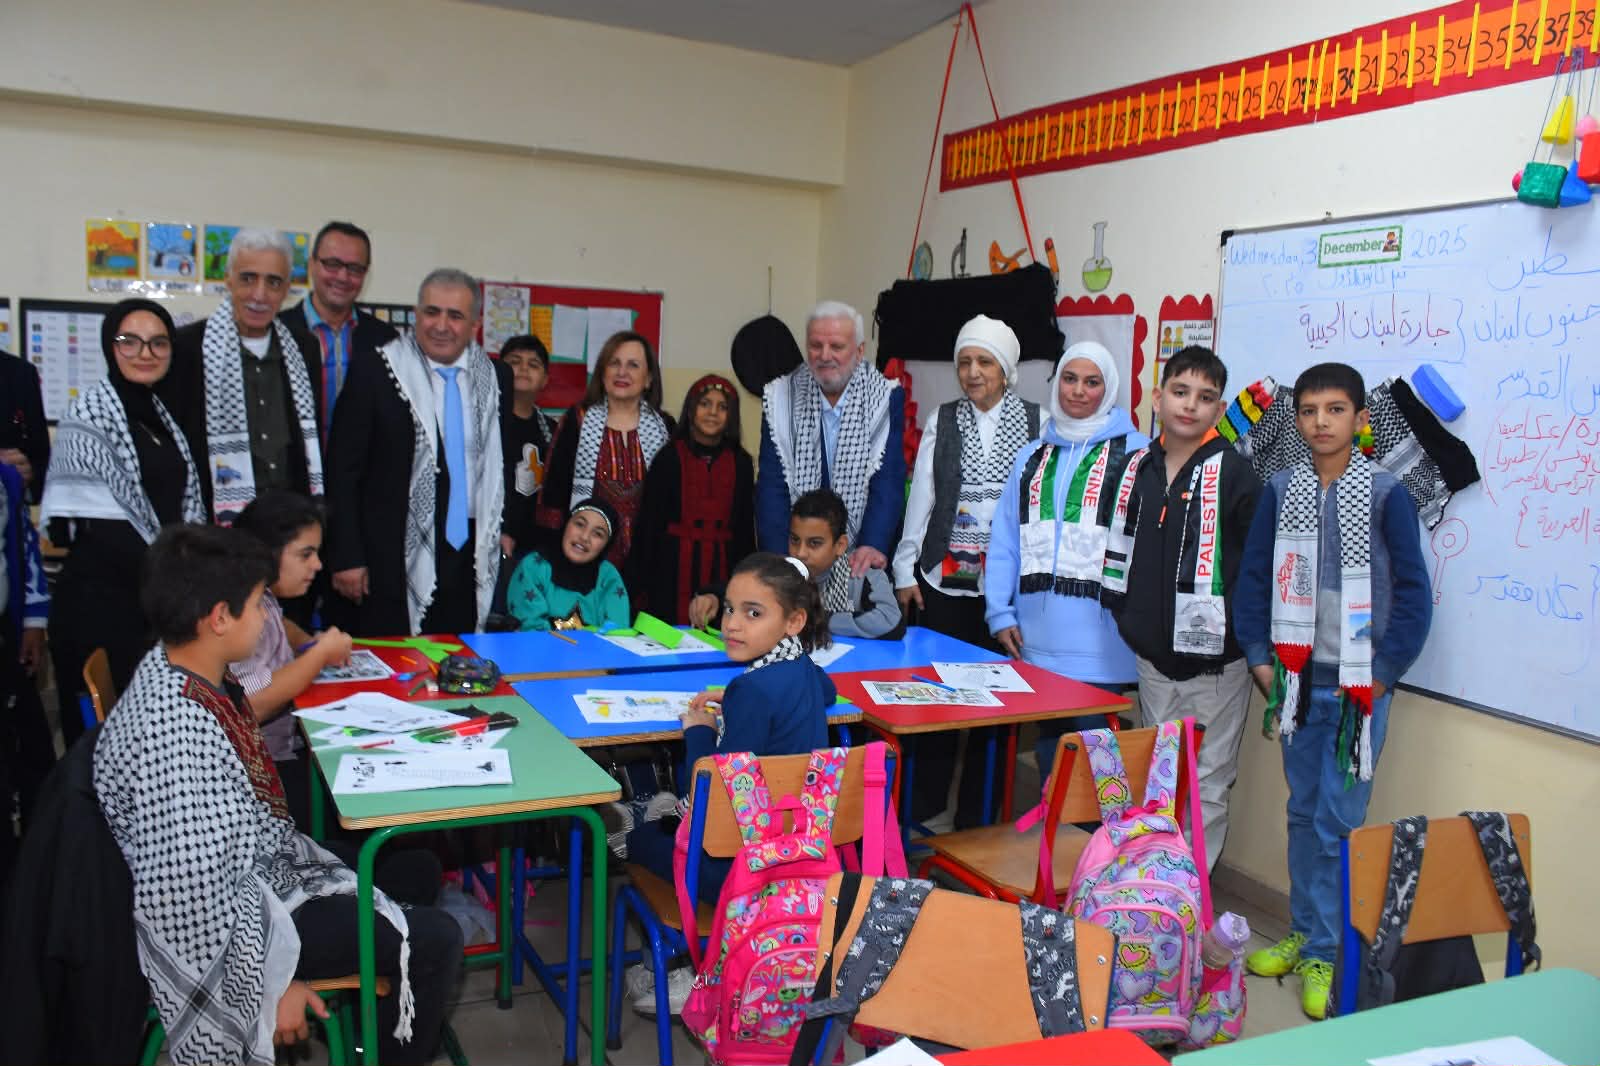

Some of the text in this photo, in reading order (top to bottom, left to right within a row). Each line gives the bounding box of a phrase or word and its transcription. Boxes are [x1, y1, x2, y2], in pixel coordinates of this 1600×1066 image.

[1178, 98, 1197, 129] 22
[1199, 93, 1218, 123] 23
[1222, 89, 1240, 119] 24
[1243, 86, 1262, 115] 25
[1268, 80, 1285, 110] 26
[1292, 77, 1307, 104] 27
[1338, 66, 1355, 96] 30
[1357, 54, 1379, 92] 31
[1387, 50, 1411, 84] 32
[1412, 44, 1438, 77] 33
[1441, 31, 1473, 70] 34
[1477, 25, 1511, 63] 35
[1512, 22, 1538, 53] 36
[1543, 11, 1571, 48] 37
[1572, 8, 1598, 39] 38
[1324, 239, 1383, 255] December
[1411, 224, 1468, 259] 2025
[1350, 292, 1397, 347] لبنان
[1397, 291, 1451, 346] جارة
[1474, 296, 1522, 347] لبنان
[1197, 463, 1219, 577] PALESTINE
